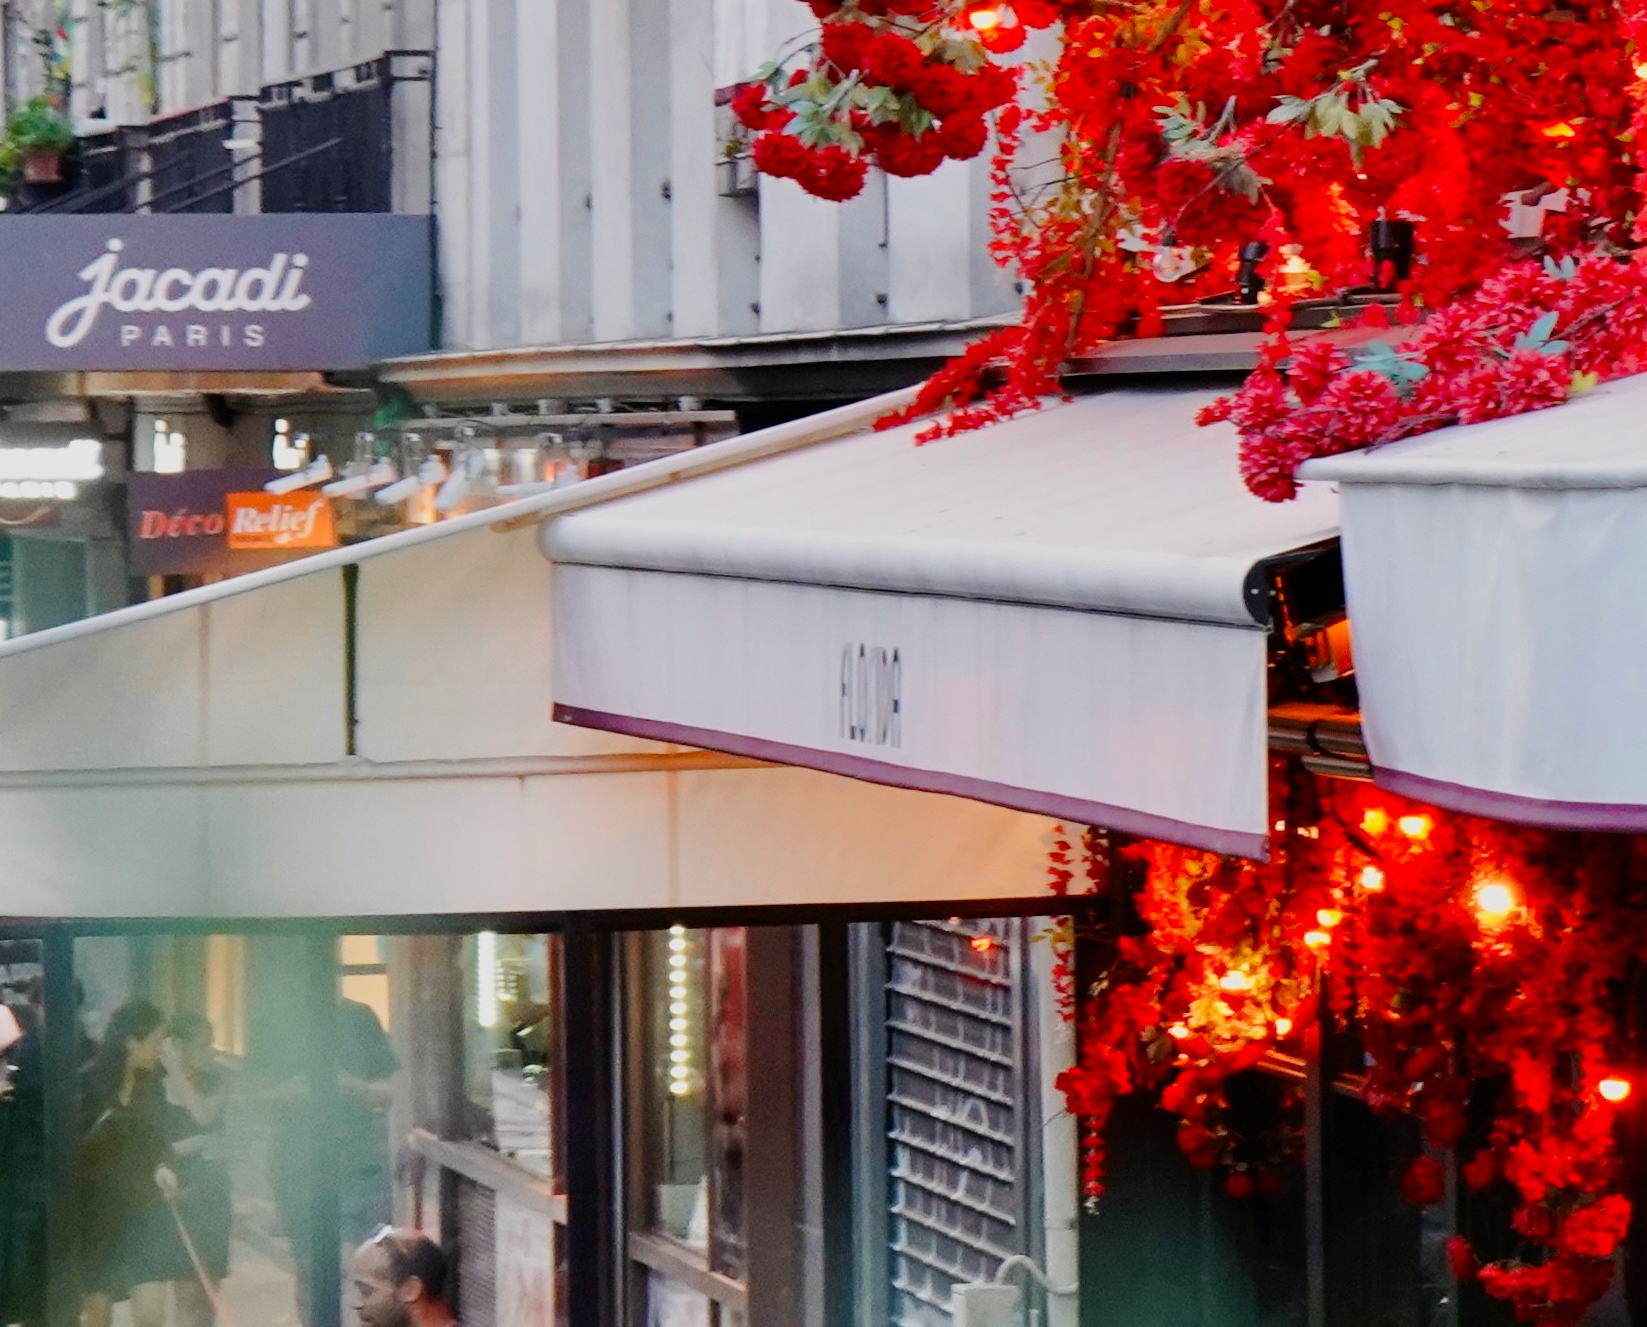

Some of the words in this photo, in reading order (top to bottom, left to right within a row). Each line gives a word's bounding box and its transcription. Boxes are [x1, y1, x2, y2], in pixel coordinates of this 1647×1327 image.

[119, 324, 266, 348] PARIS
[139, 507, 224, 540] Déco
[231, 502, 325, 544] Relief
